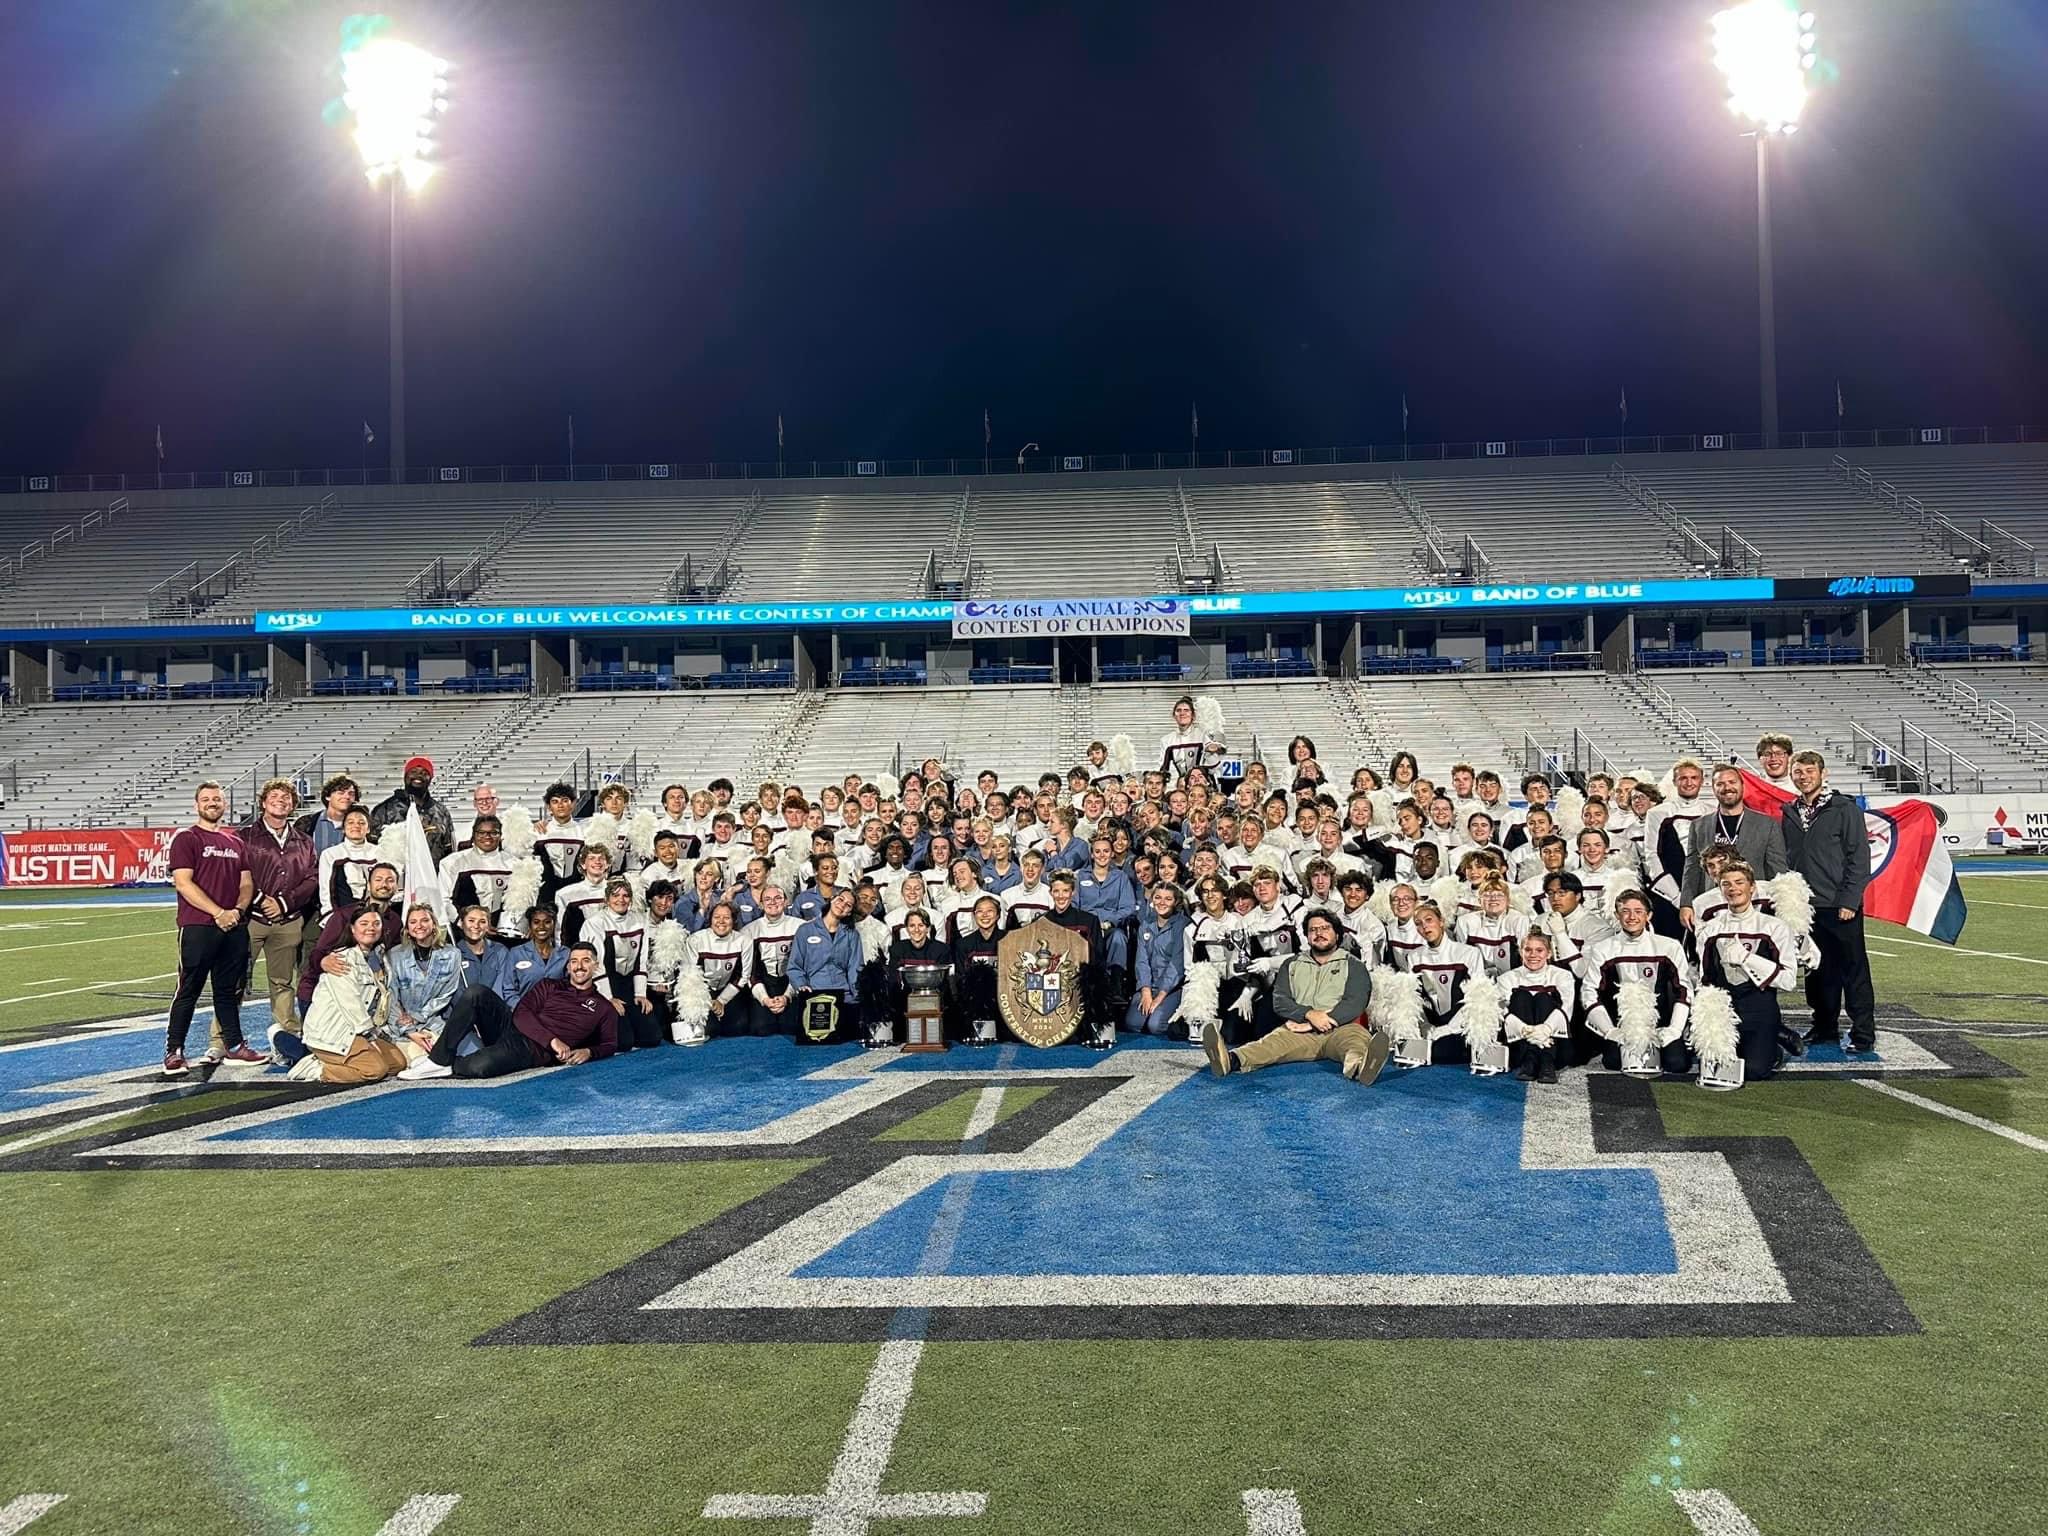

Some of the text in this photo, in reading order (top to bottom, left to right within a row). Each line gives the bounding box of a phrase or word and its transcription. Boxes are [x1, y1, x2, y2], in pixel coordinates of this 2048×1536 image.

[1403, 591, 1461, 603] MTSU
[1472, 585, 1643, 600] BAND OF BLUE
[411, 613, 472, 625] BAND
[477, 613, 506, 625] OF
[513, 612, 562, 624] BLUE
[568, 610, 687, 624] WELCOMES
[698, 609, 733, 621] THE
[739, 608, 833, 621] CONTEST
[841, 607, 870, 619] OF
[1013, 601, 1128, 617] 61st ANNUAL
[267, 614, 322, 627] MTSU
[957, 617, 1185, 635] CONTEST OF CHAMPIONS
[1223, 761, 1241, 777] 2H
[153, 831, 170, 845] FM
[31, 844, 46, 853] JUST
[48, 843, 71, 853] WATCH
[75, 843, 87, 852] THE
[138, 848, 154, 862] FM
[202, 845, 240, 859] Franklin
[9, 855, 115, 881] LISTEN
[122, 865, 139, 880] AM
[1000, 993, 1030, 1040] CONTEST
[1030, 1035, 1043, 1047] OF
